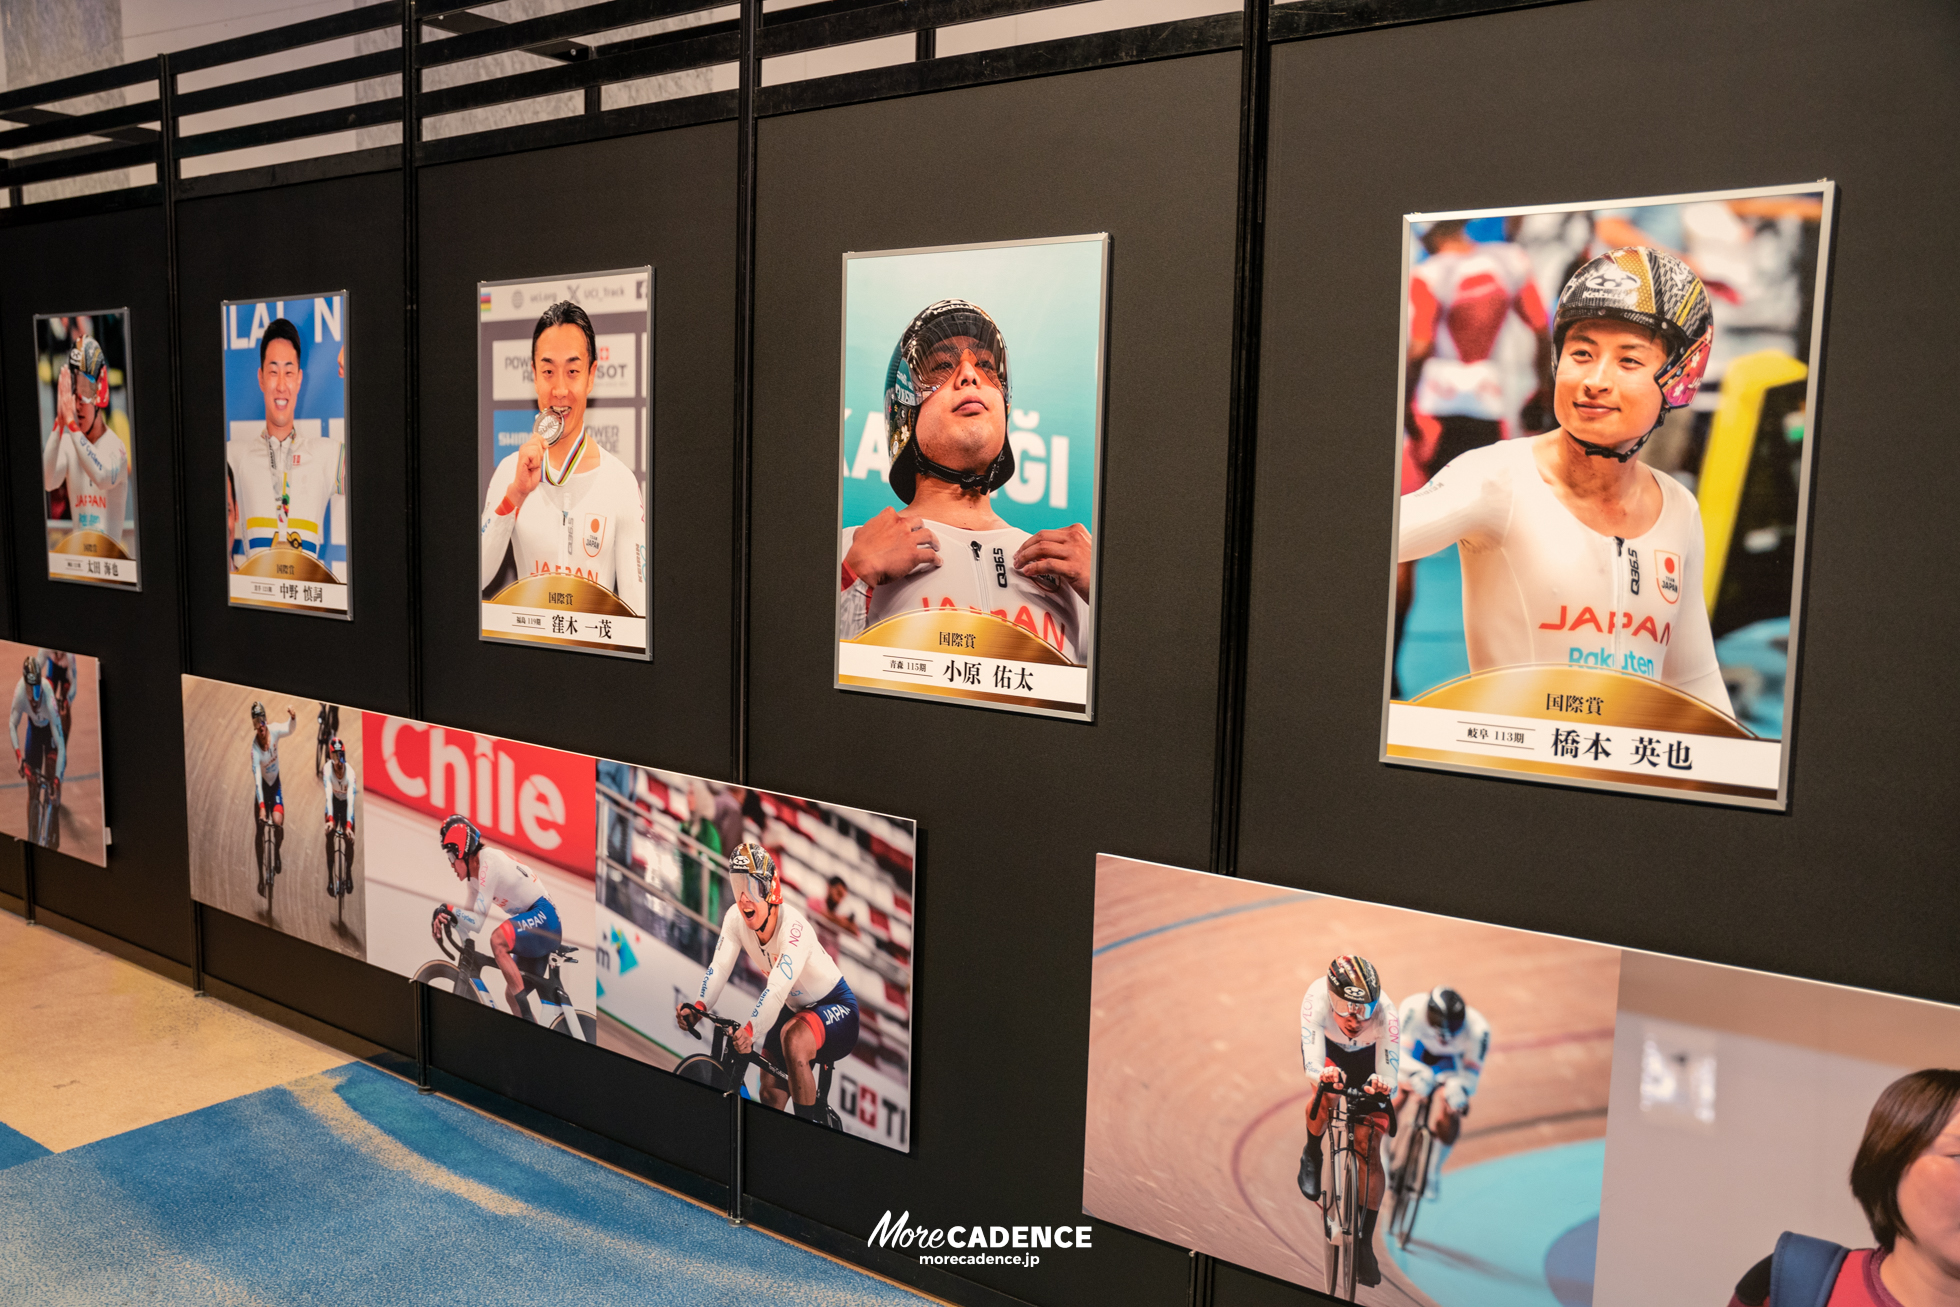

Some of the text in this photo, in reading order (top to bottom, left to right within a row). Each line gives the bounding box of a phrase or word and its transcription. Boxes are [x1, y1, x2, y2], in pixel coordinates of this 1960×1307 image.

[1627, 547, 1640, 596] Q36.5
[280, 582, 299, 601] 中野
[1661, 580, 1678, 593] JAPAN
[548, 591, 574, 606] 国際賞
[552, 614, 612, 640] 窪木 一茂
[1538, 605, 1672, 647] JAPAN
[938, 631, 977, 649] 国際賞
[889, 658, 927, 673] 青森 115期
[942, 659, 1034, 692] 小原 佑太
[1545, 692, 1604, 717] 国際賞
[1467, 726, 1525, 744] 岐阜 113期
[1551, 727, 1694, 771] 橋本 英也
[381, 714, 566, 851] Chile
[517, 911, 548, 933] JAPAN
